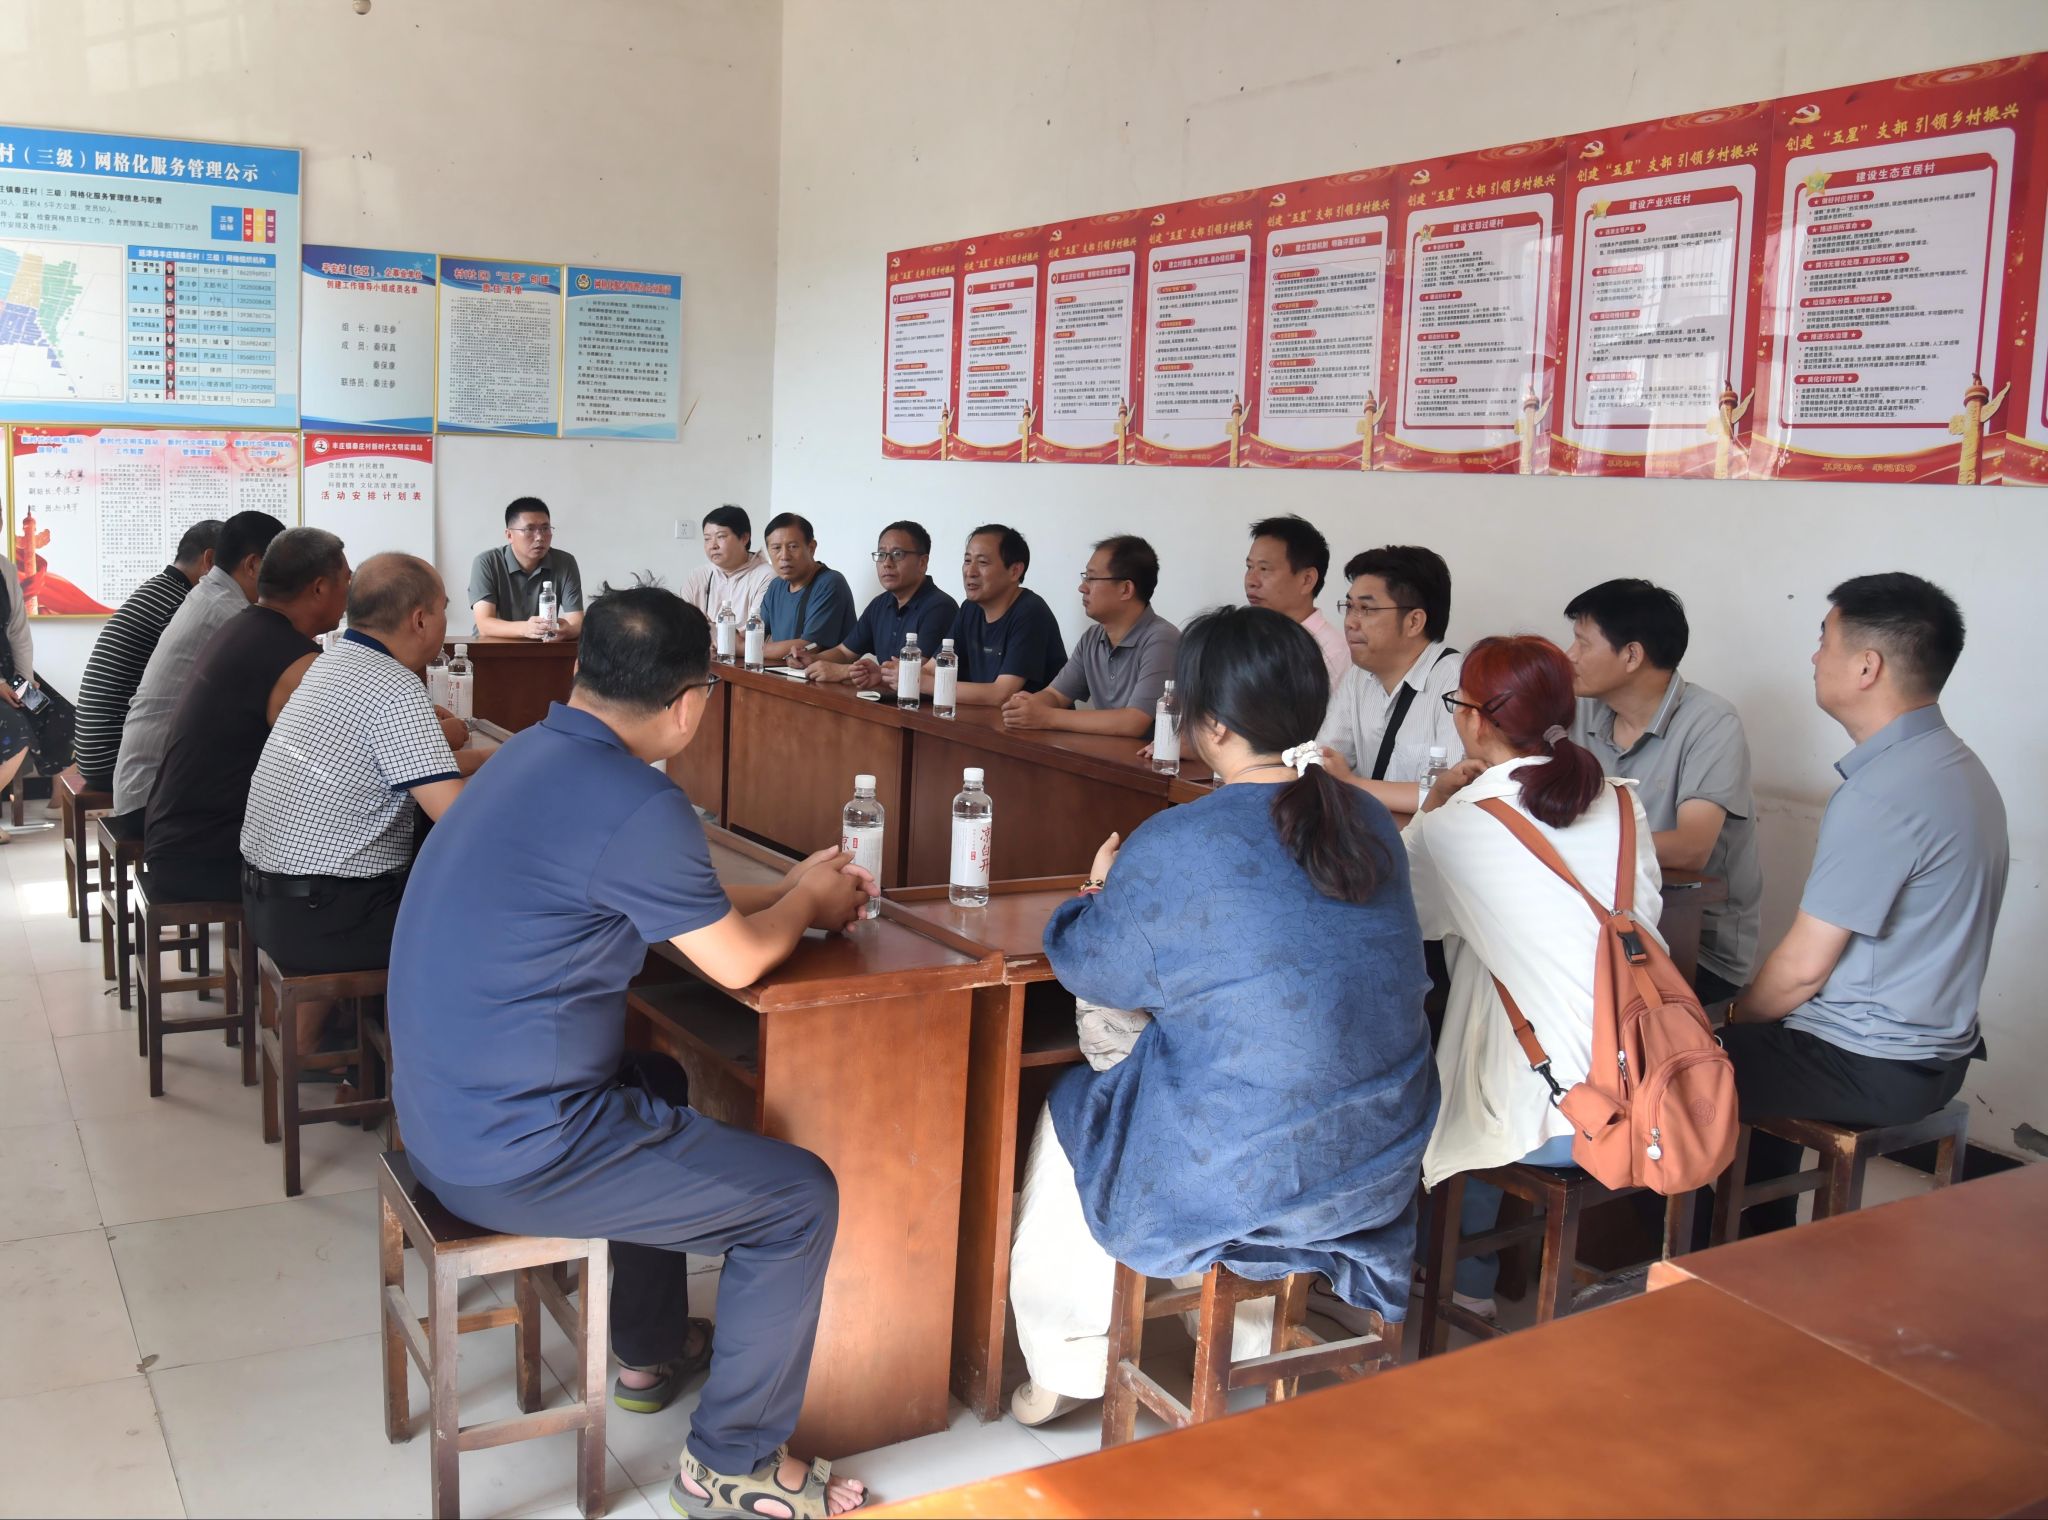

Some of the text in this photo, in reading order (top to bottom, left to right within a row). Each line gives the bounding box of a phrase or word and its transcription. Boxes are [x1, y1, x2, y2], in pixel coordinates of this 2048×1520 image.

[1856, 162, 1935, 183] 建设生态宜居村
[1629, 194, 1691, 211] 建设产业兴旺村
[1453, 218, 1504, 233] 建设支部过硬村
[327, 280, 418, 294] 创建工作领导小组成员名单
[321, 491, 421, 501] 活动安排计划表
